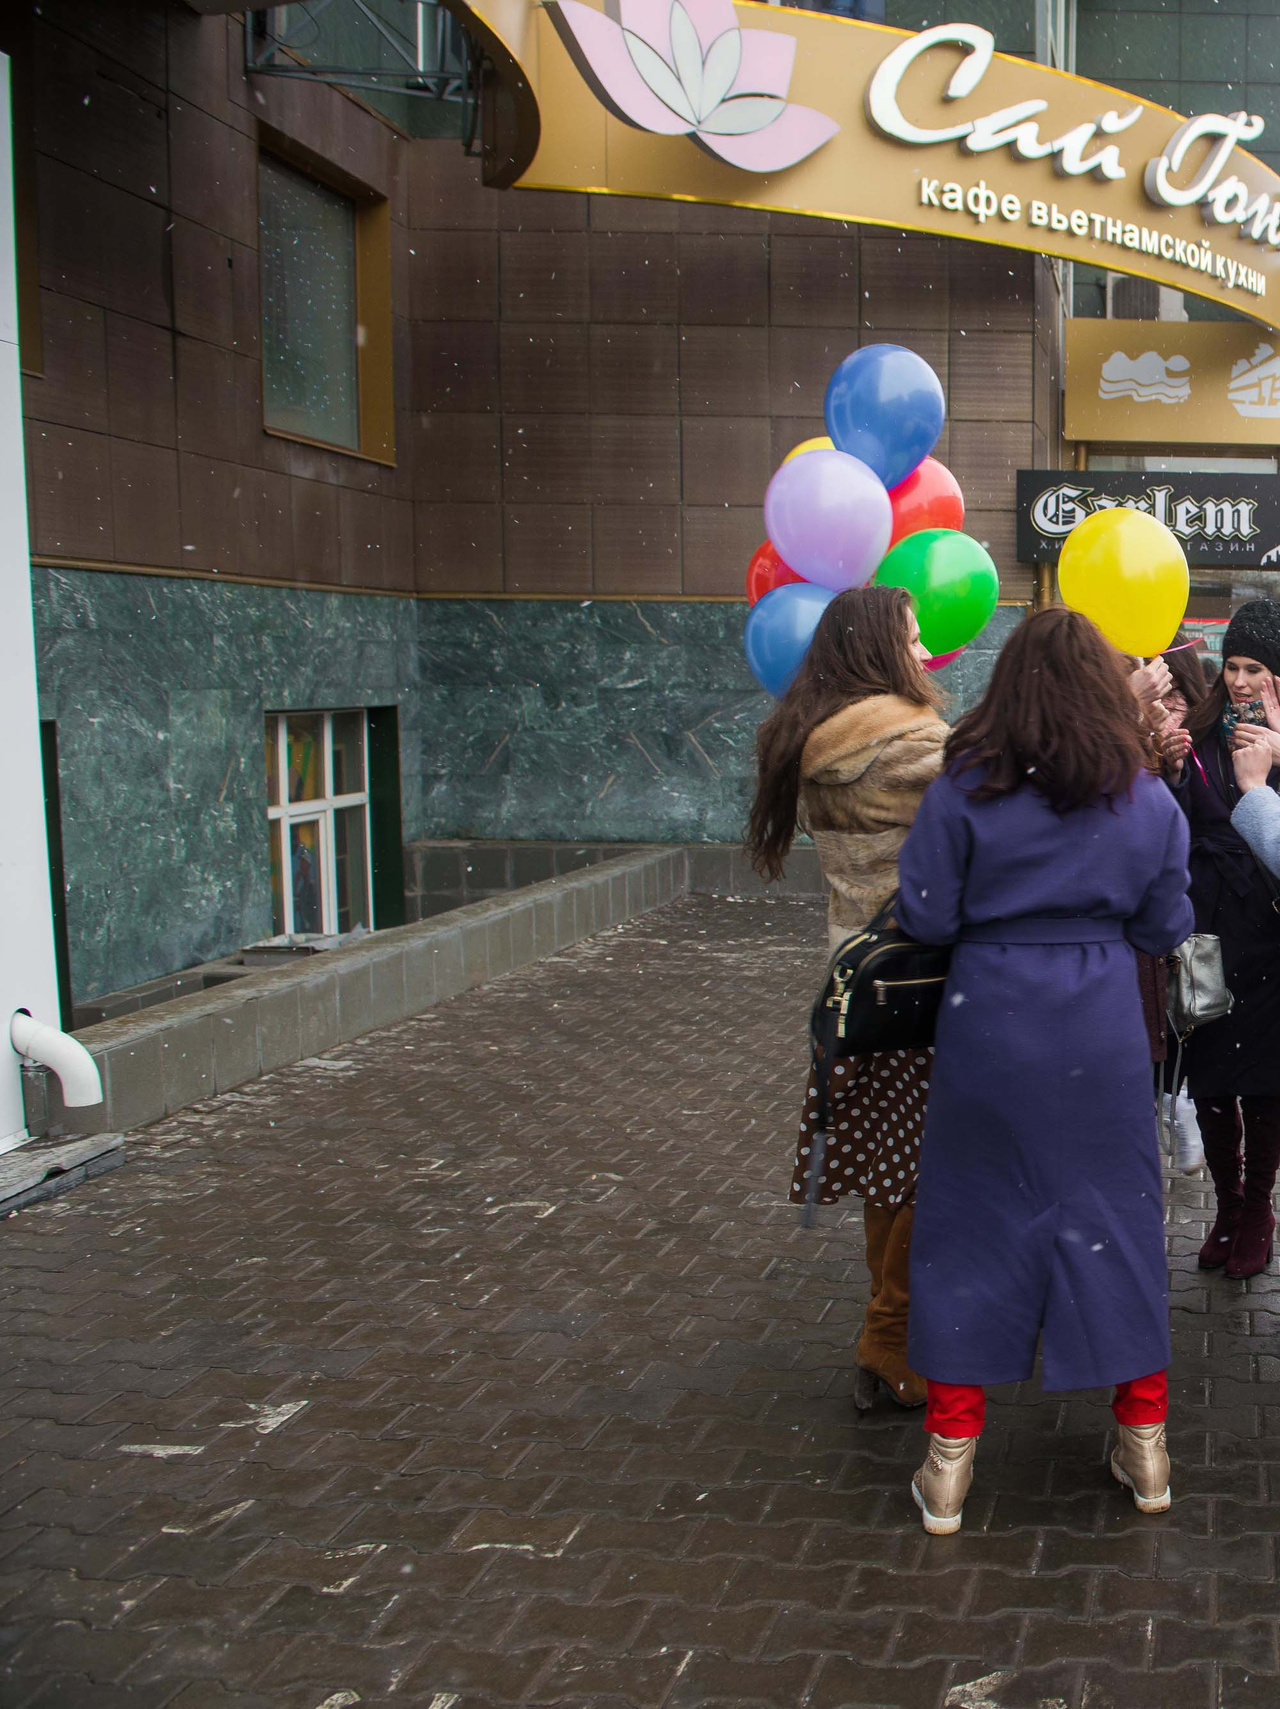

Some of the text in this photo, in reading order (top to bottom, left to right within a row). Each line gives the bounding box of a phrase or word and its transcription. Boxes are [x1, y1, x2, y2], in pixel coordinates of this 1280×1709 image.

[919, 177, 1267, 297] кафе вьетнамской кухни
[1185, 541, 1256, 552] ГАЗИН
